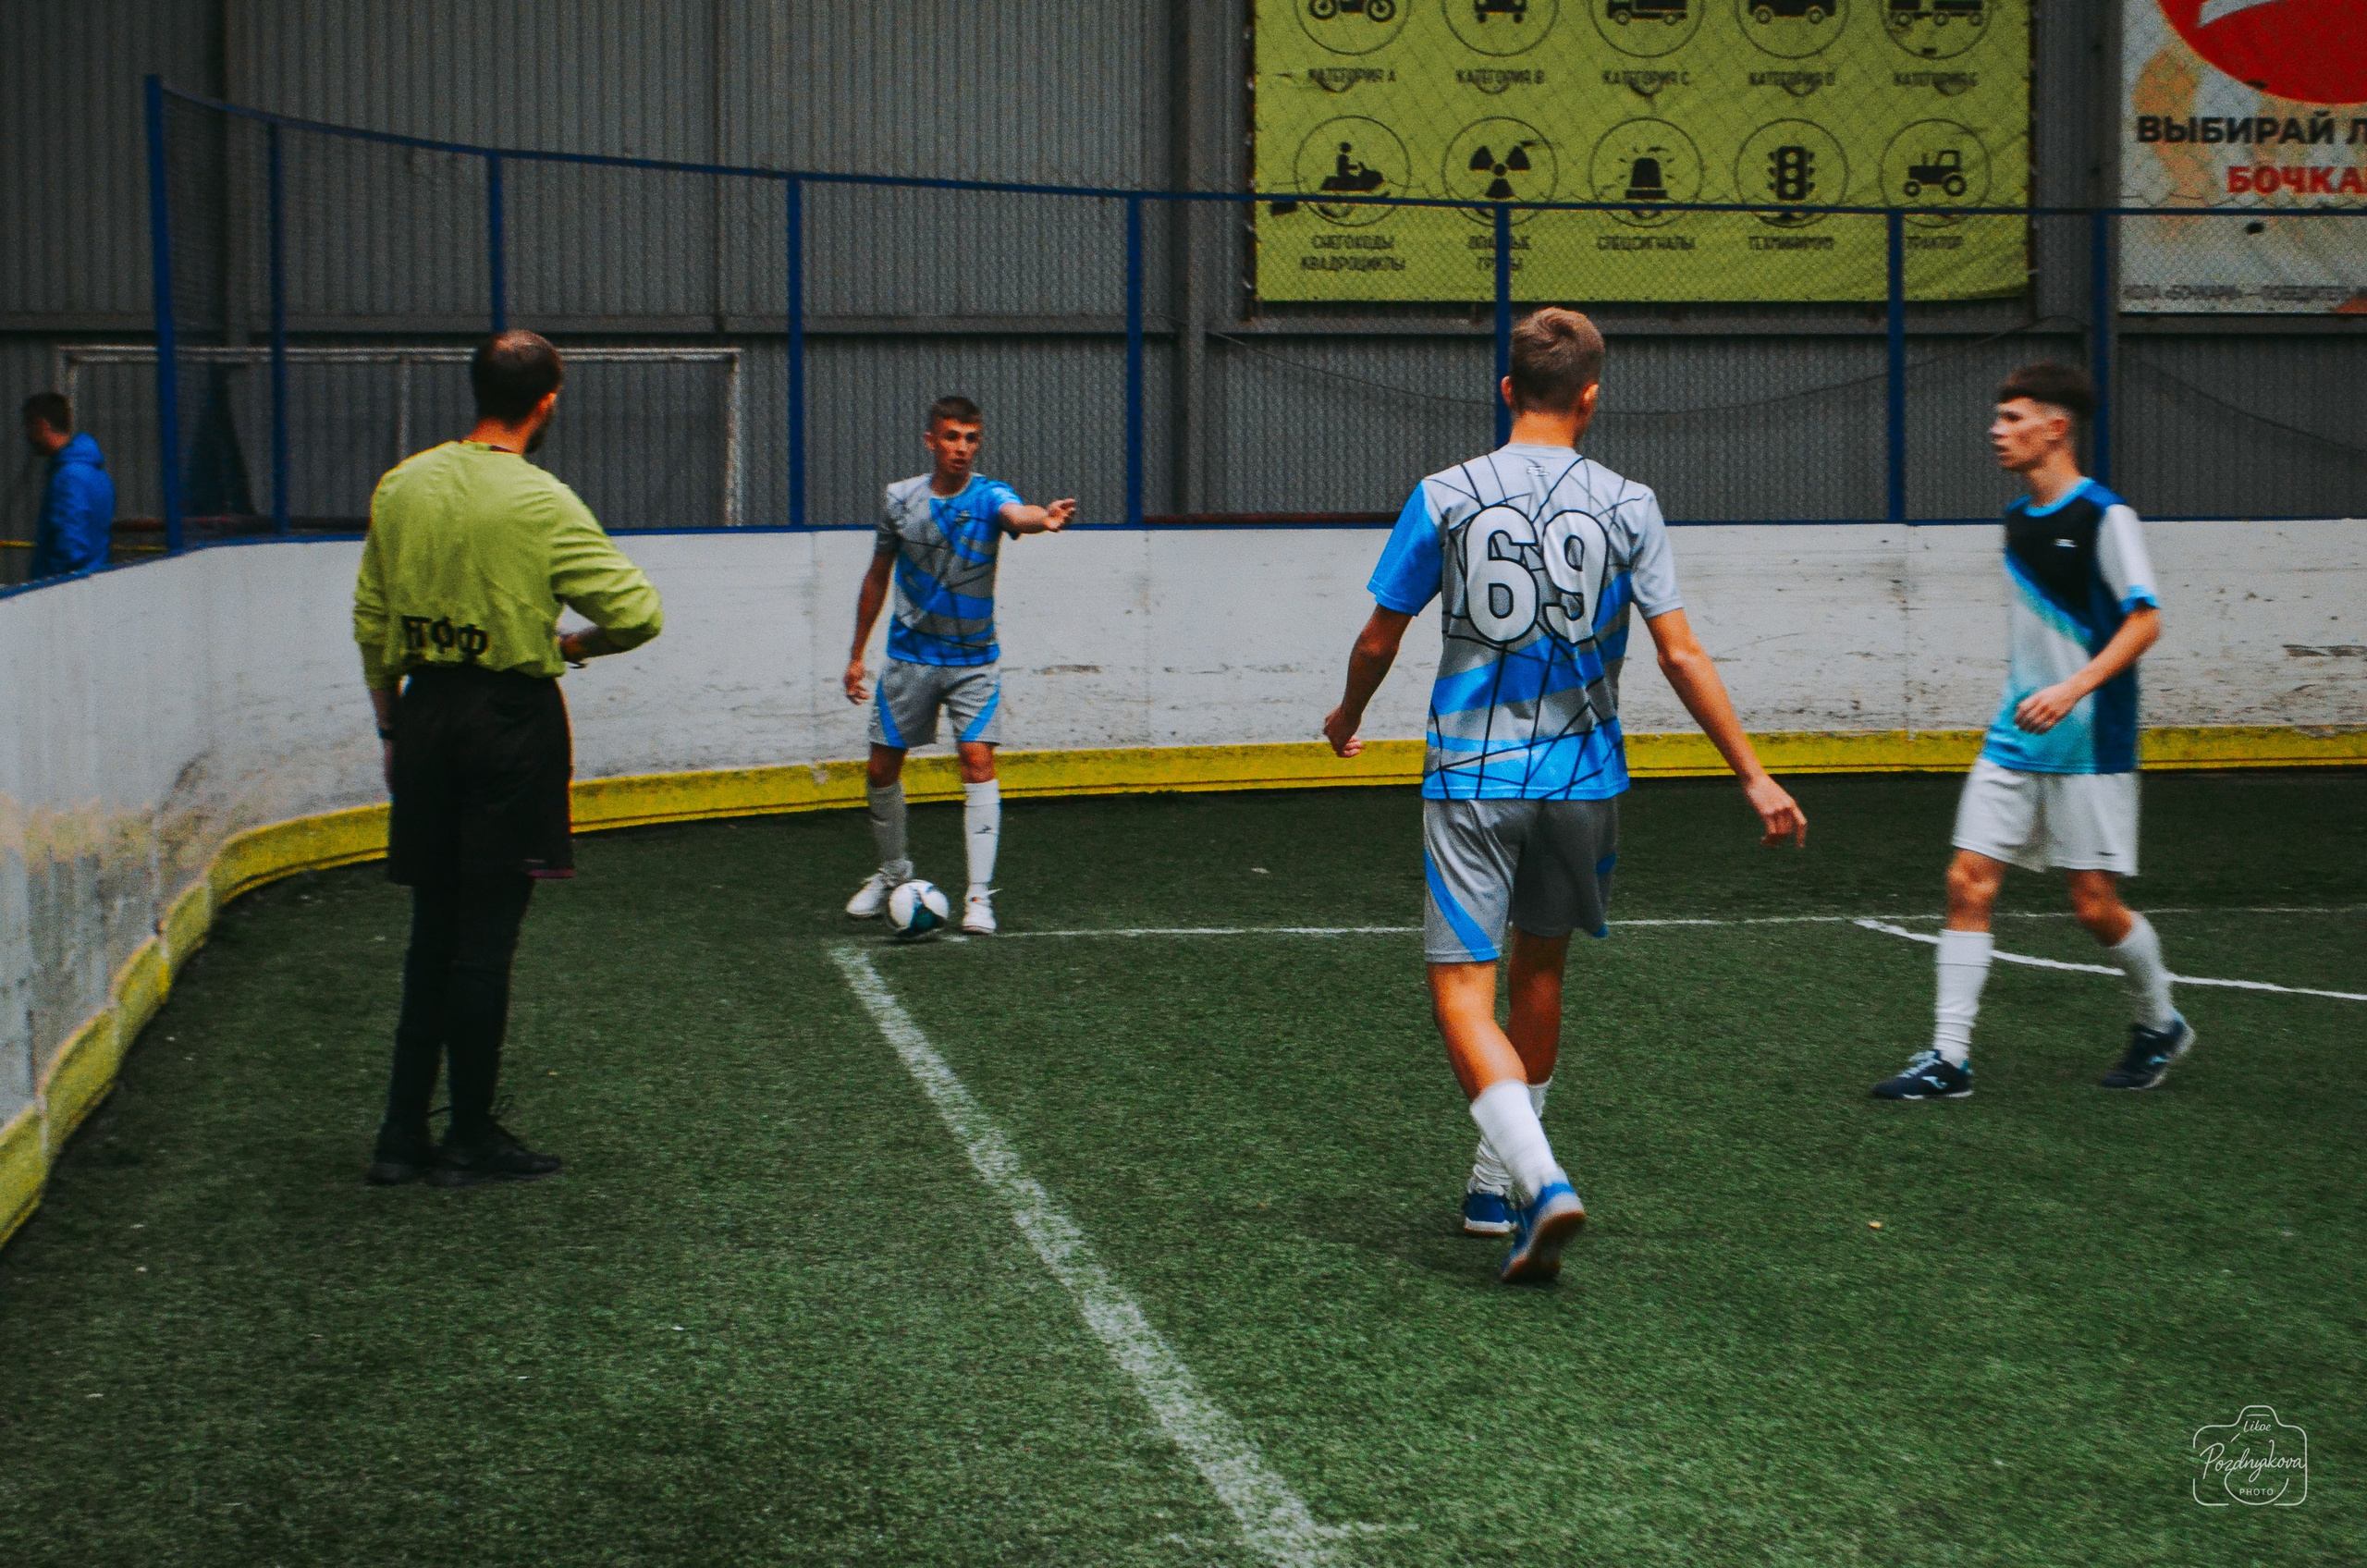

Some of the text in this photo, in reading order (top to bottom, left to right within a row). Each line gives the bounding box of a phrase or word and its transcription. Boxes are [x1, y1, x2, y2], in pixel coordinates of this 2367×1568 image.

[2138, 110, 2335, 144] ВЫБИРАЙ
[2226, 165, 2367, 195] БОЧКА
[1464, 504, 1610, 644] 69
